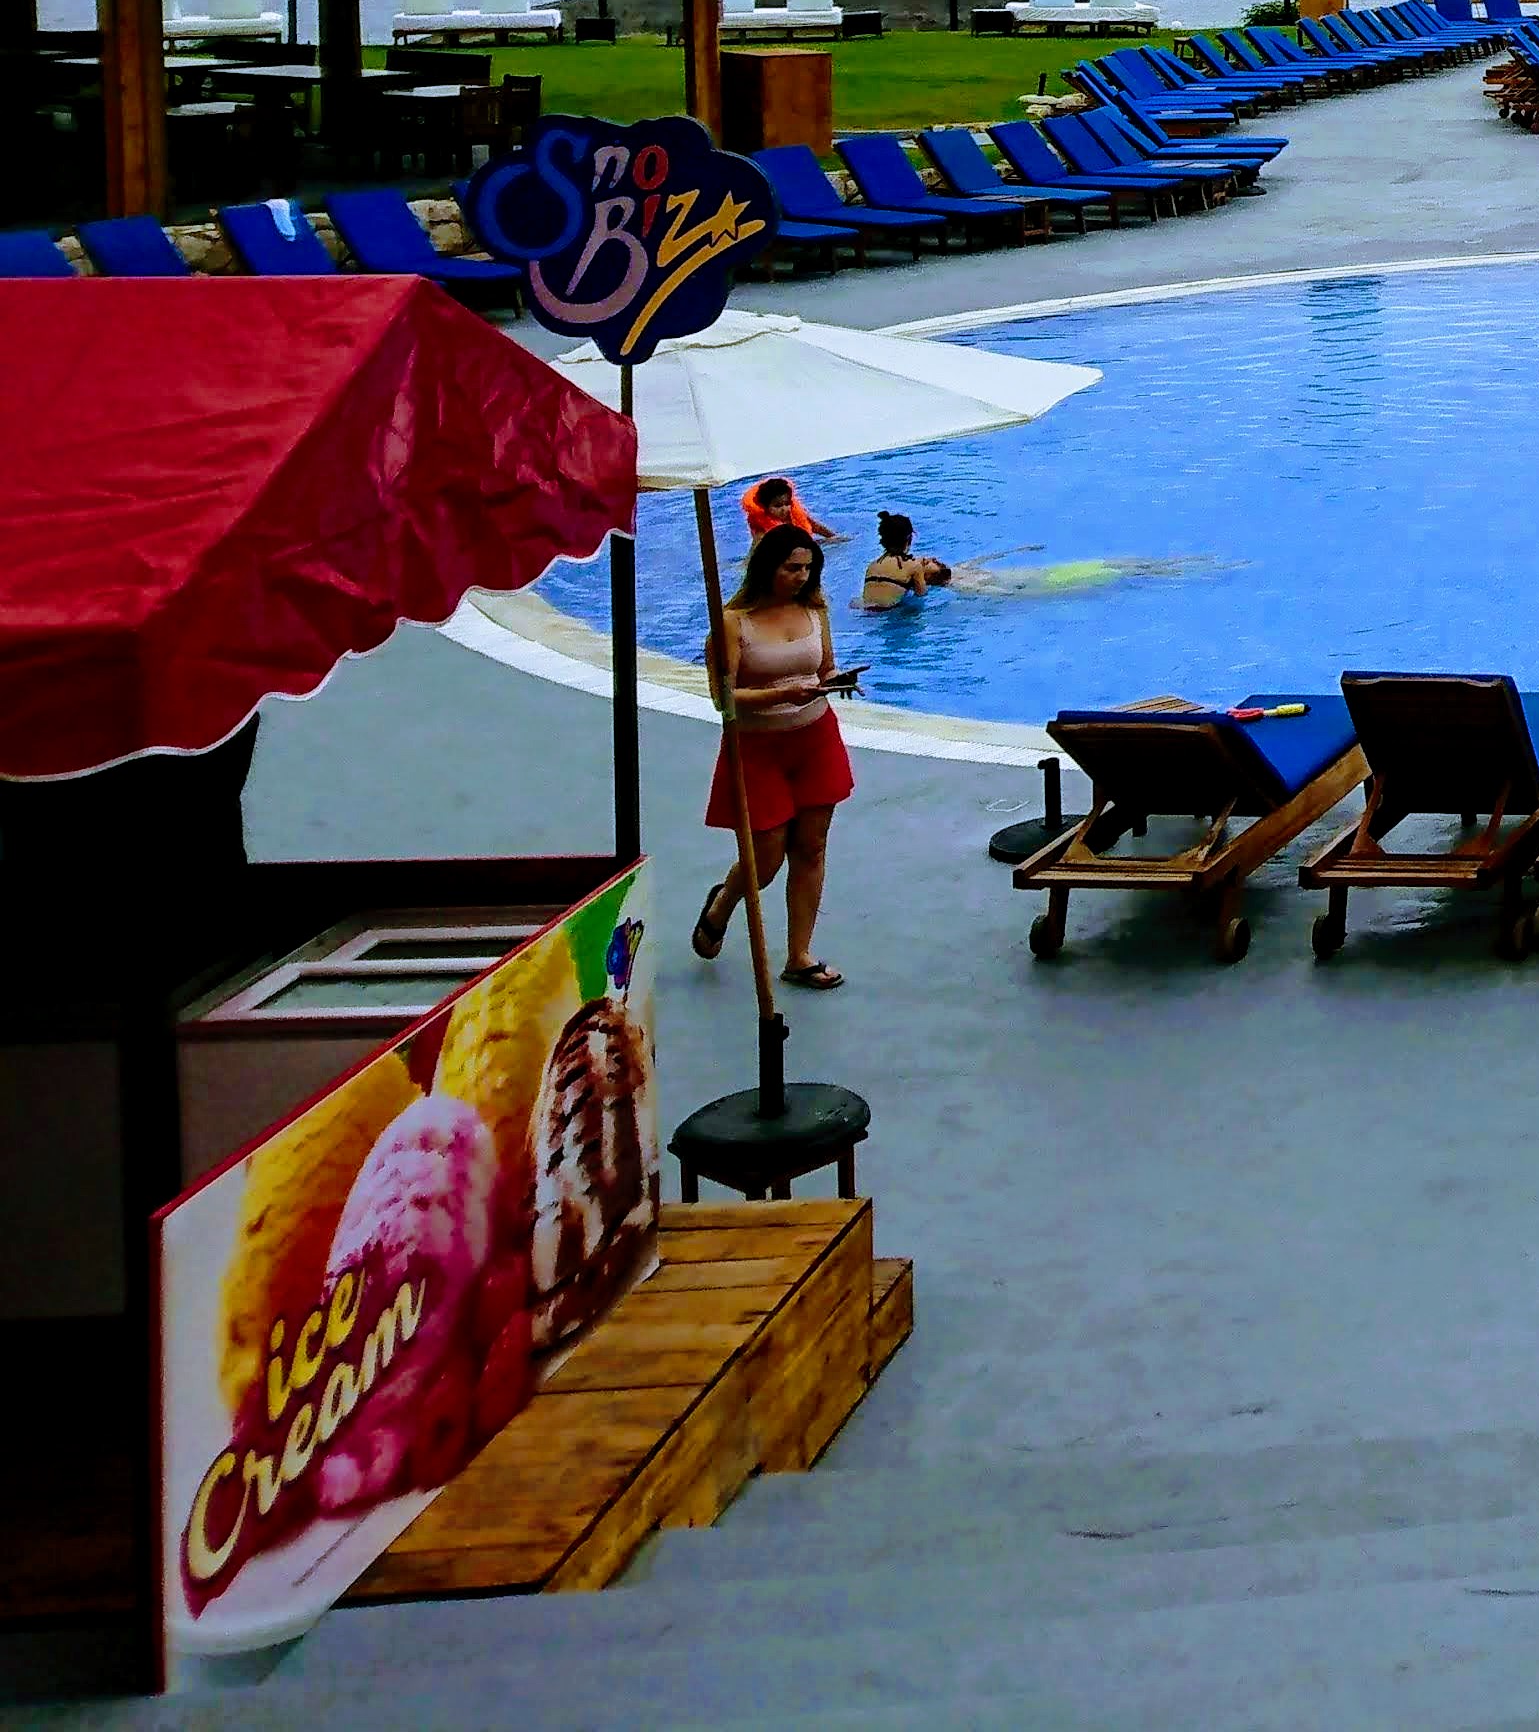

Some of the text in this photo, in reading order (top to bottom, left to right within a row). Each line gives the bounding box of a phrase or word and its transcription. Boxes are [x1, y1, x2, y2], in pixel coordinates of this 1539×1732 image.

[478, 129, 669, 260] Sno
[267, 1268, 365, 1421] ice
[188, 1278, 426, 1580] Cream
